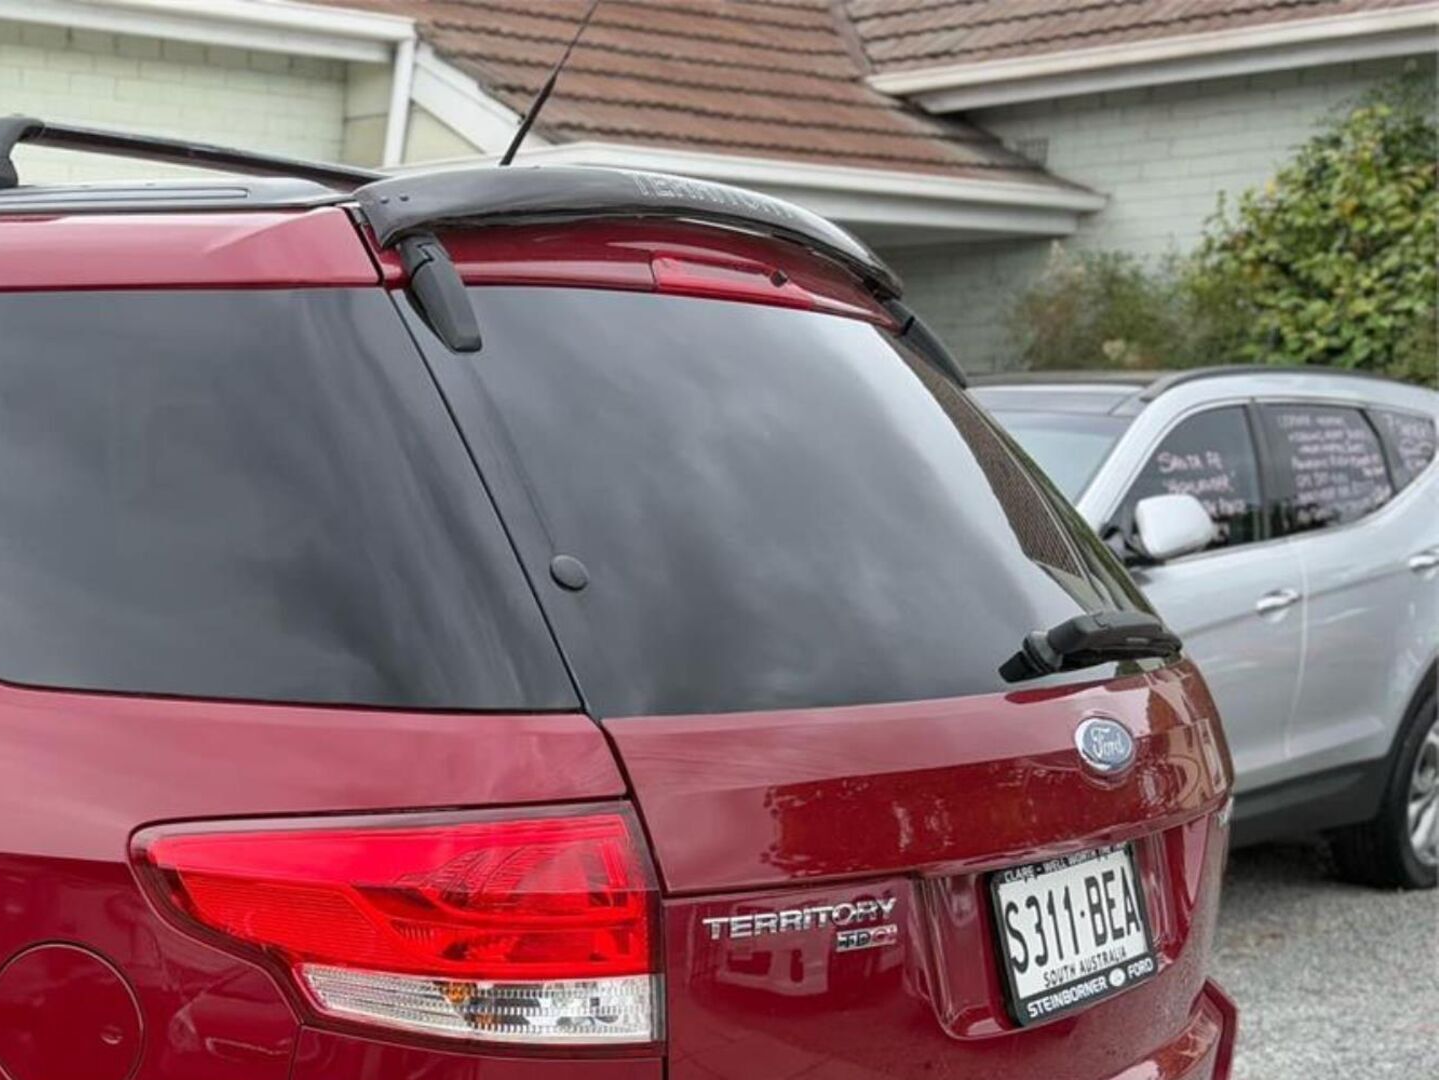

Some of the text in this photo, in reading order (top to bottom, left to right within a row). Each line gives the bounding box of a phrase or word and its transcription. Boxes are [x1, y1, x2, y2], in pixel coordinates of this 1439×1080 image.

[1090, 726, 1124, 758] Ford
[702, 897, 896, 941] TERRITORY
[1026, 957, 1154, 1018] STEINBORNER FORD
[1043, 946, 1127, 988] SOUTH AUSTRALIA
